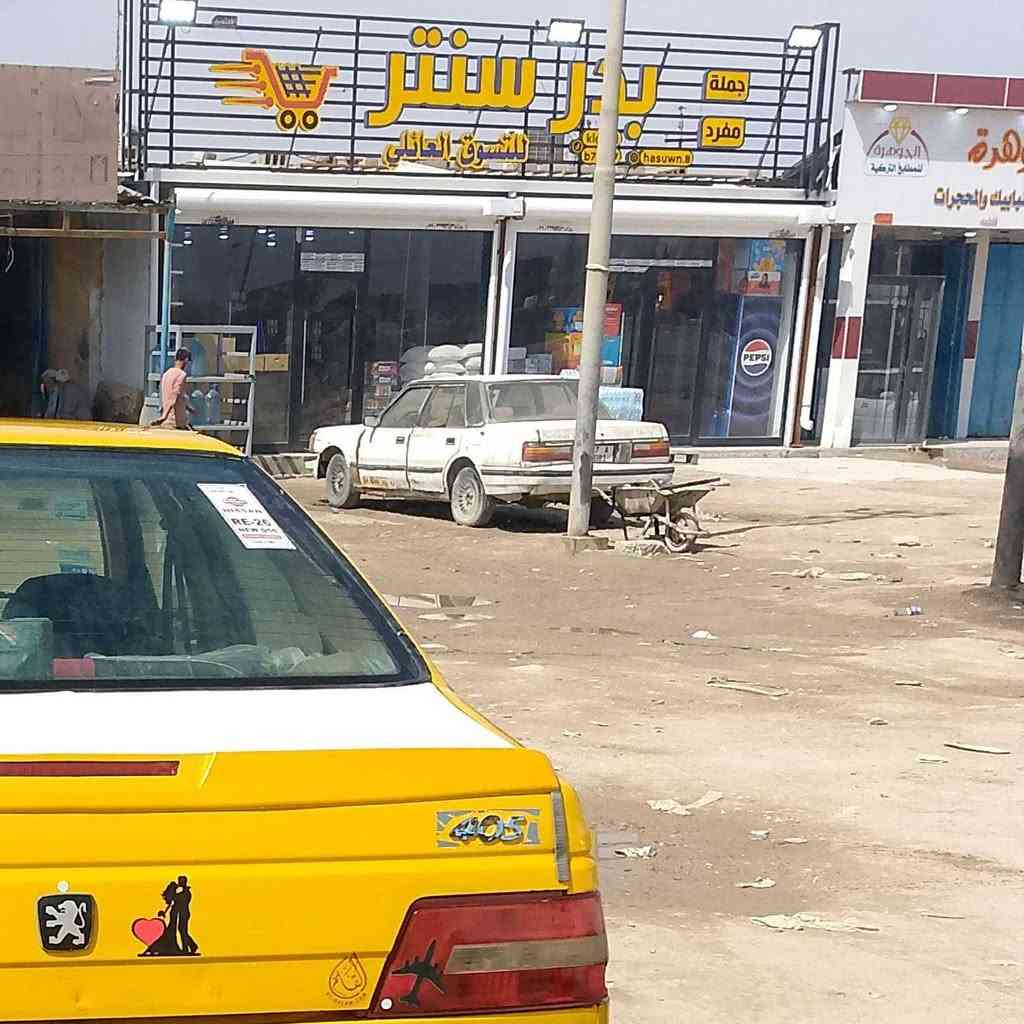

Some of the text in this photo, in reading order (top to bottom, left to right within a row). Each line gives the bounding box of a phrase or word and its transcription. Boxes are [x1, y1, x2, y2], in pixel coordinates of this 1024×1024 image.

[365, 26, 538, 129] سنتر
[709, 74, 746, 97] جملة
[705, 122, 741, 142] مفرد
[383, 129, 529, 169] للتسوق العائلي
[968, 128, 1024, 174] هرة
[743, 353, 770, 362] PEPSI
[449, 815, 528, 846] 405
